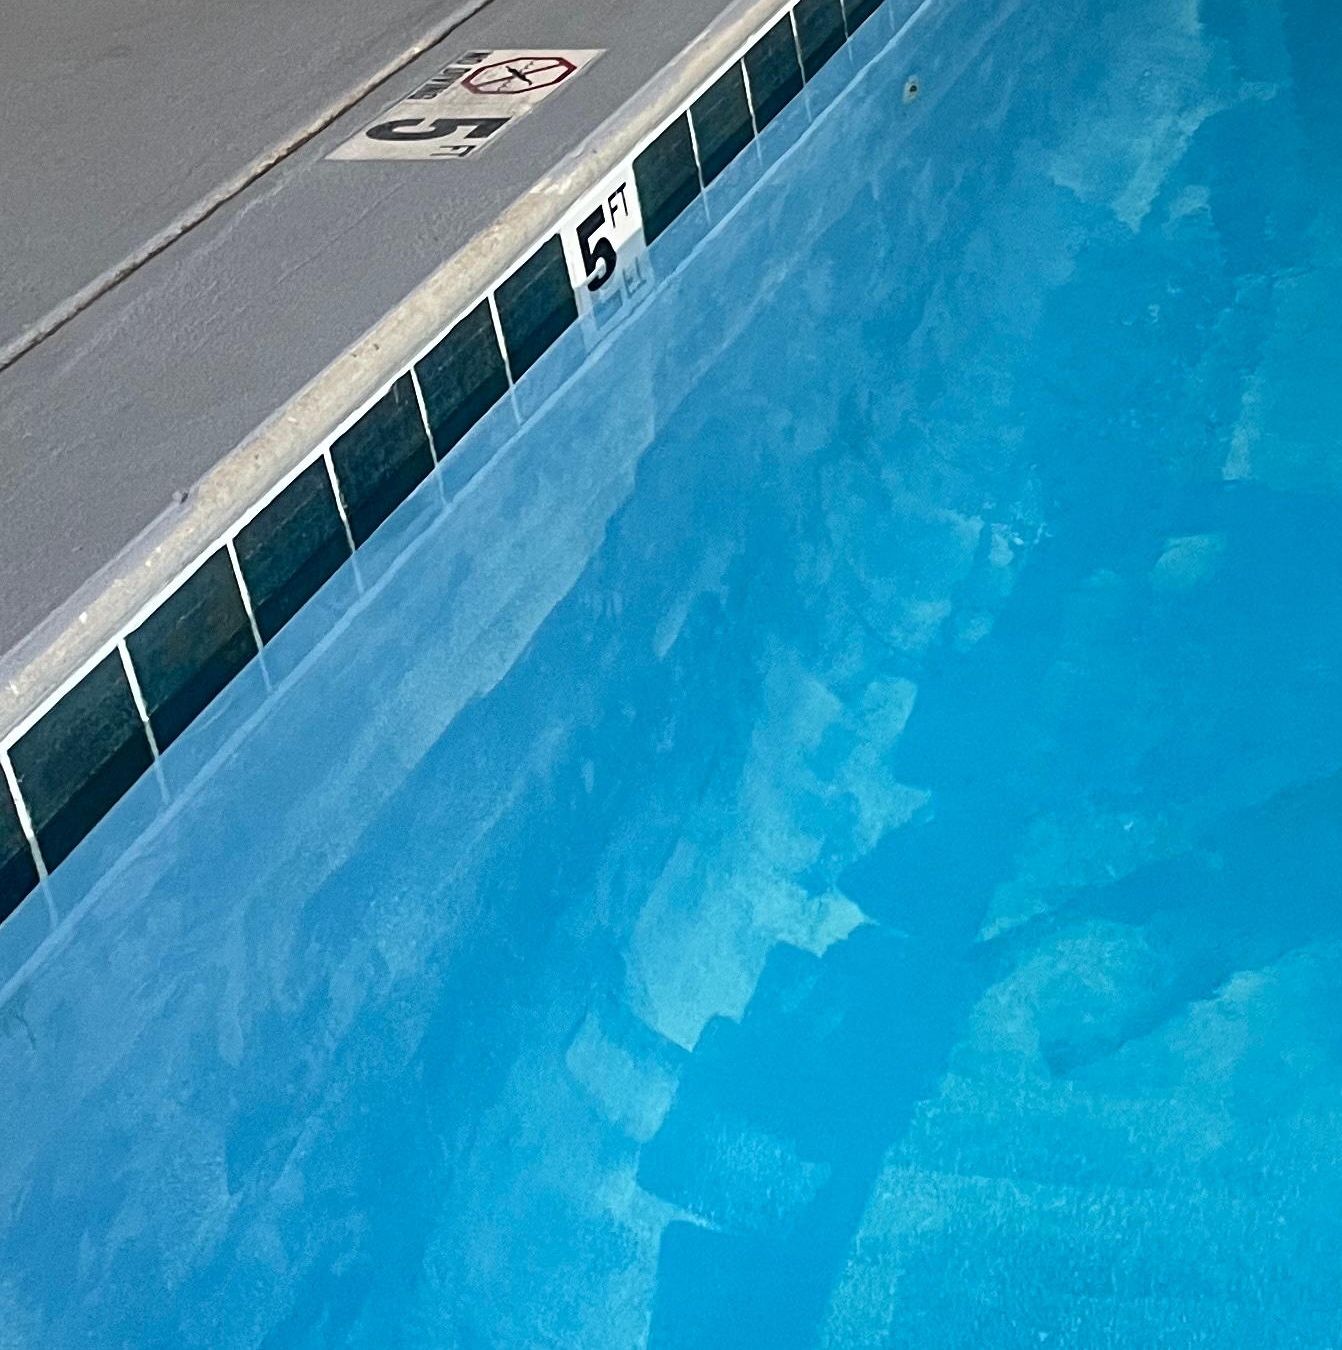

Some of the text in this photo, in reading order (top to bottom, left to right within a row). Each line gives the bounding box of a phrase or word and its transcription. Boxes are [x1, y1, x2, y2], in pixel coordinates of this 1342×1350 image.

[366, 117, 512, 141] 5
[576, 182, 628, 292] 5 FT
